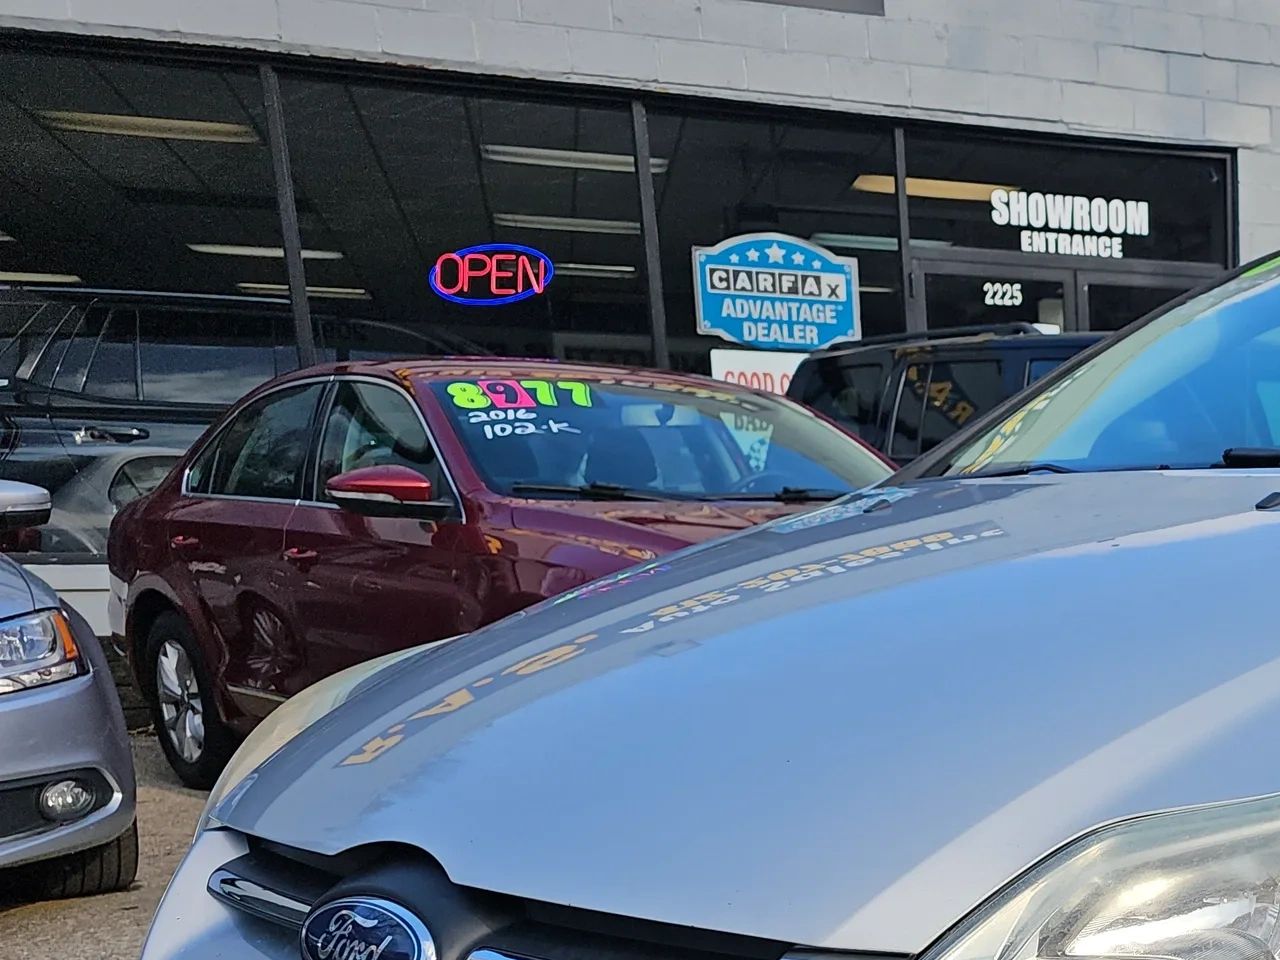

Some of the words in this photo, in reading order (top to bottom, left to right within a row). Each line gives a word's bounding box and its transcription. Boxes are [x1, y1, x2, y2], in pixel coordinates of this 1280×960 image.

[991, 188, 1149, 236] SHOWROOM
[1020, 230, 1123, 259] ENTRANCE
[435, 252, 545, 294] OPEN
[711, 268, 841, 300] CARFAX
[983, 281, 1023, 306] 2225
[721, 298, 838, 324] ADVANTAGE
[742, 320, 819, 345] DEALER
[446, 379, 593, 408] 8977
[468, 408, 537, 424] 2016
